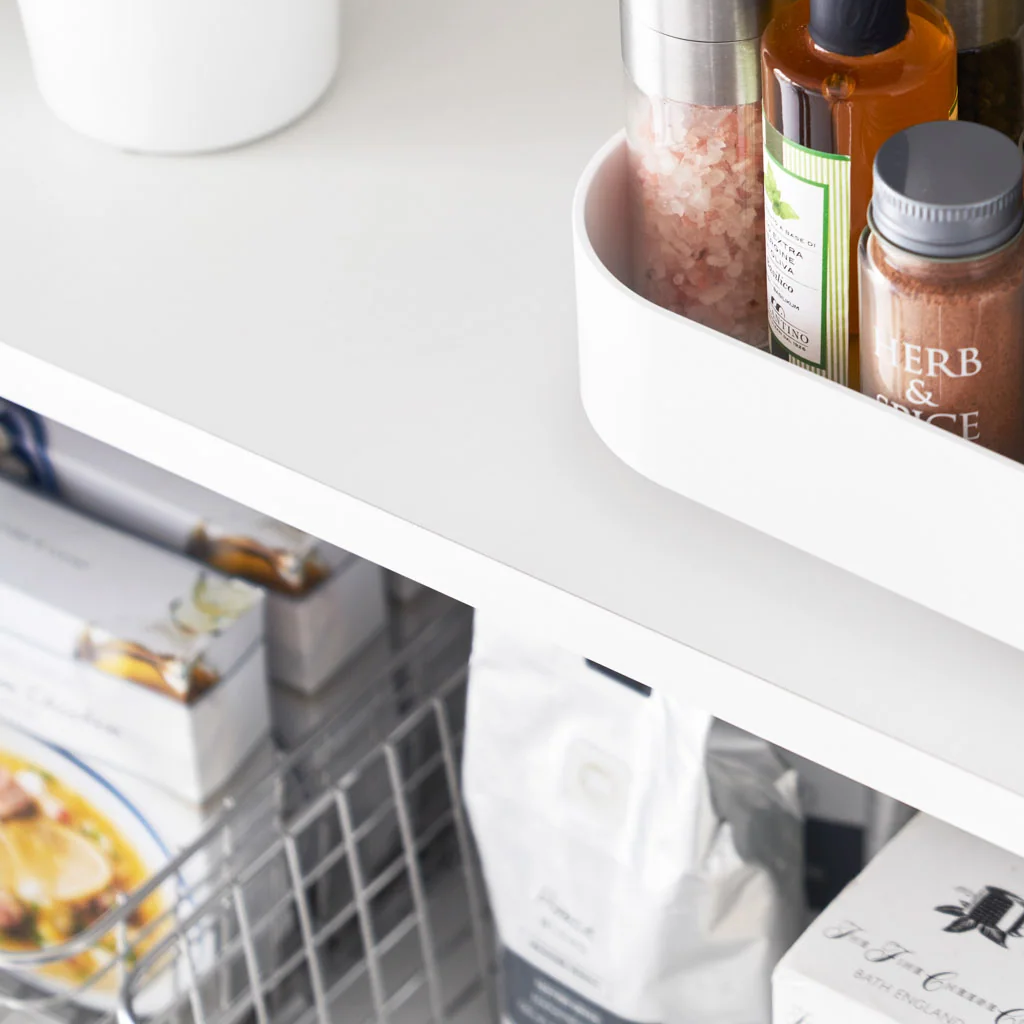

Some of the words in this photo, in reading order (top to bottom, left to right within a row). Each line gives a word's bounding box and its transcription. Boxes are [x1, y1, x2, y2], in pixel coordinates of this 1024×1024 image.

[772, 232, 804, 260] EXTRA
[874, 326, 983, 378] HERB
[905, 378, 940, 407] &
[853, 968, 892, 993] BATH
[893, 988, 966, 1024] ENGLAND
